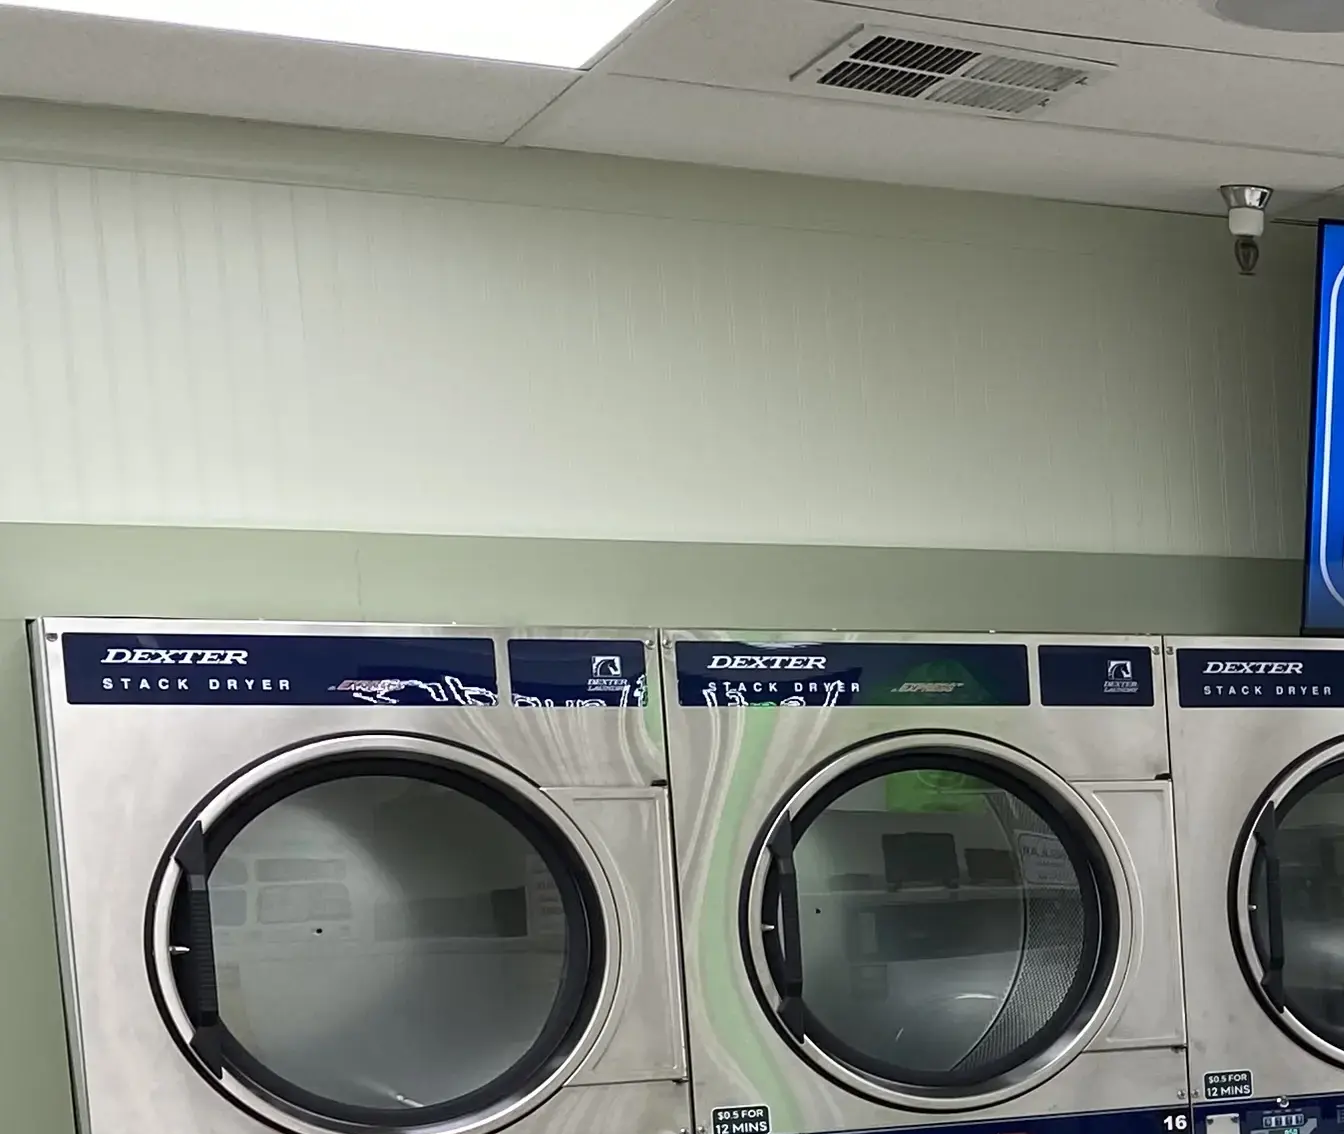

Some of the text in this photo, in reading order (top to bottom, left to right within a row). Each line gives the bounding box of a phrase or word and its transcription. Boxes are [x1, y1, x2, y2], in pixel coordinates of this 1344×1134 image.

[100, 649, 249, 665] DEXTER
[707, 655, 827, 669] DEXTER
[1203, 661, 1304, 674] DEXTER
[103, 677, 291, 691] STACK DRYER
[587, 678, 628, 686] DEXTER
[708, 682, 860, 693] STACK DRYER
[1203, 685, 1332, 696] STACK DRYER
[1208, 1073, 1248, 1084] $0.5 FOR
[1206, 1084, 1251, 1097] 12 MINS
[717, 1108, 764, 1121] $0.5 FOR
[715, 1121, 768, 1134] 12 MINS
[1163, 1115, 1187, 1131] 16
